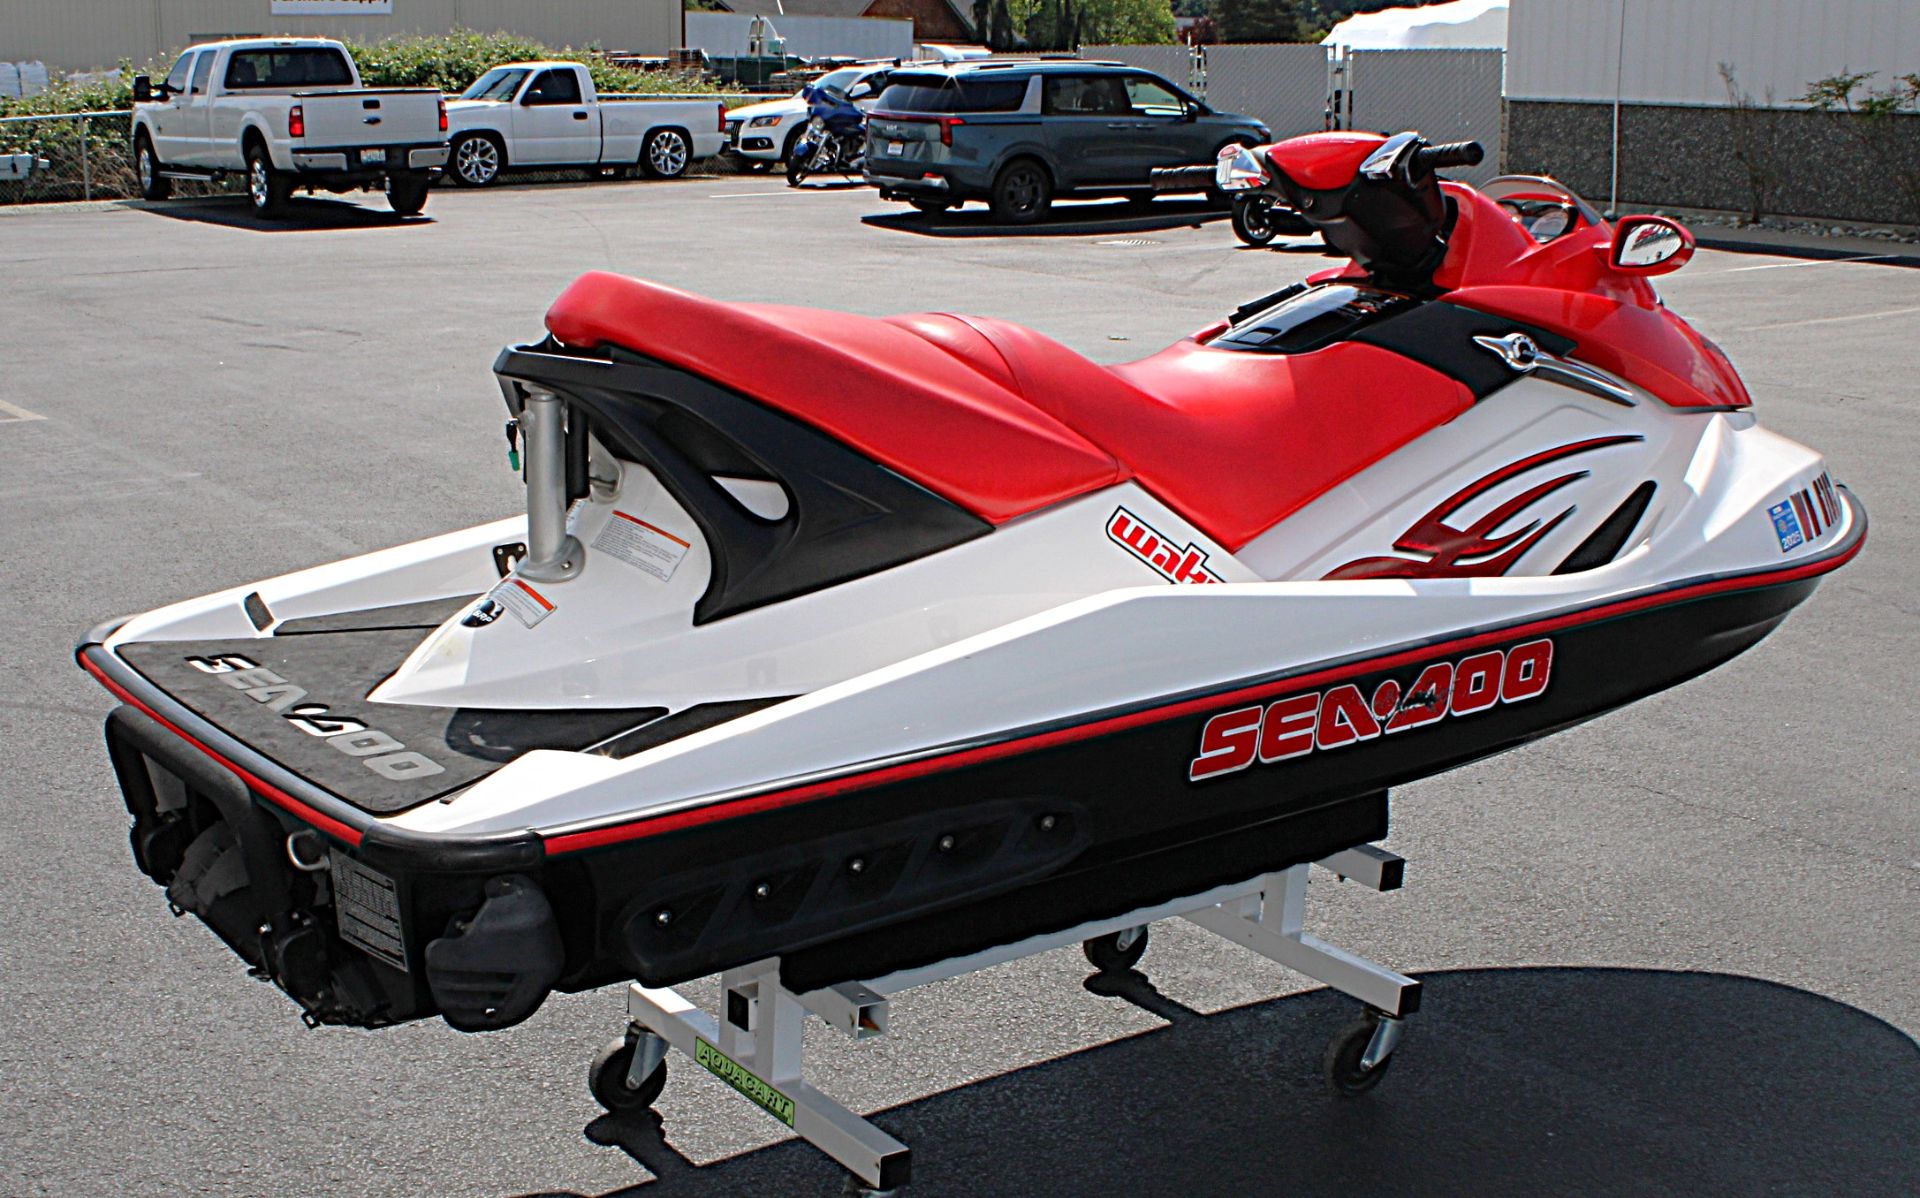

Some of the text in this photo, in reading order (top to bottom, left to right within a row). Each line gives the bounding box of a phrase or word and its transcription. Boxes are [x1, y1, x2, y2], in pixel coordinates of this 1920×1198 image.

[1111, 513, 1217, 585] wak
[472, 610, 493, 622] BRP
[699, 1046, 790, 1113] AQUACART
